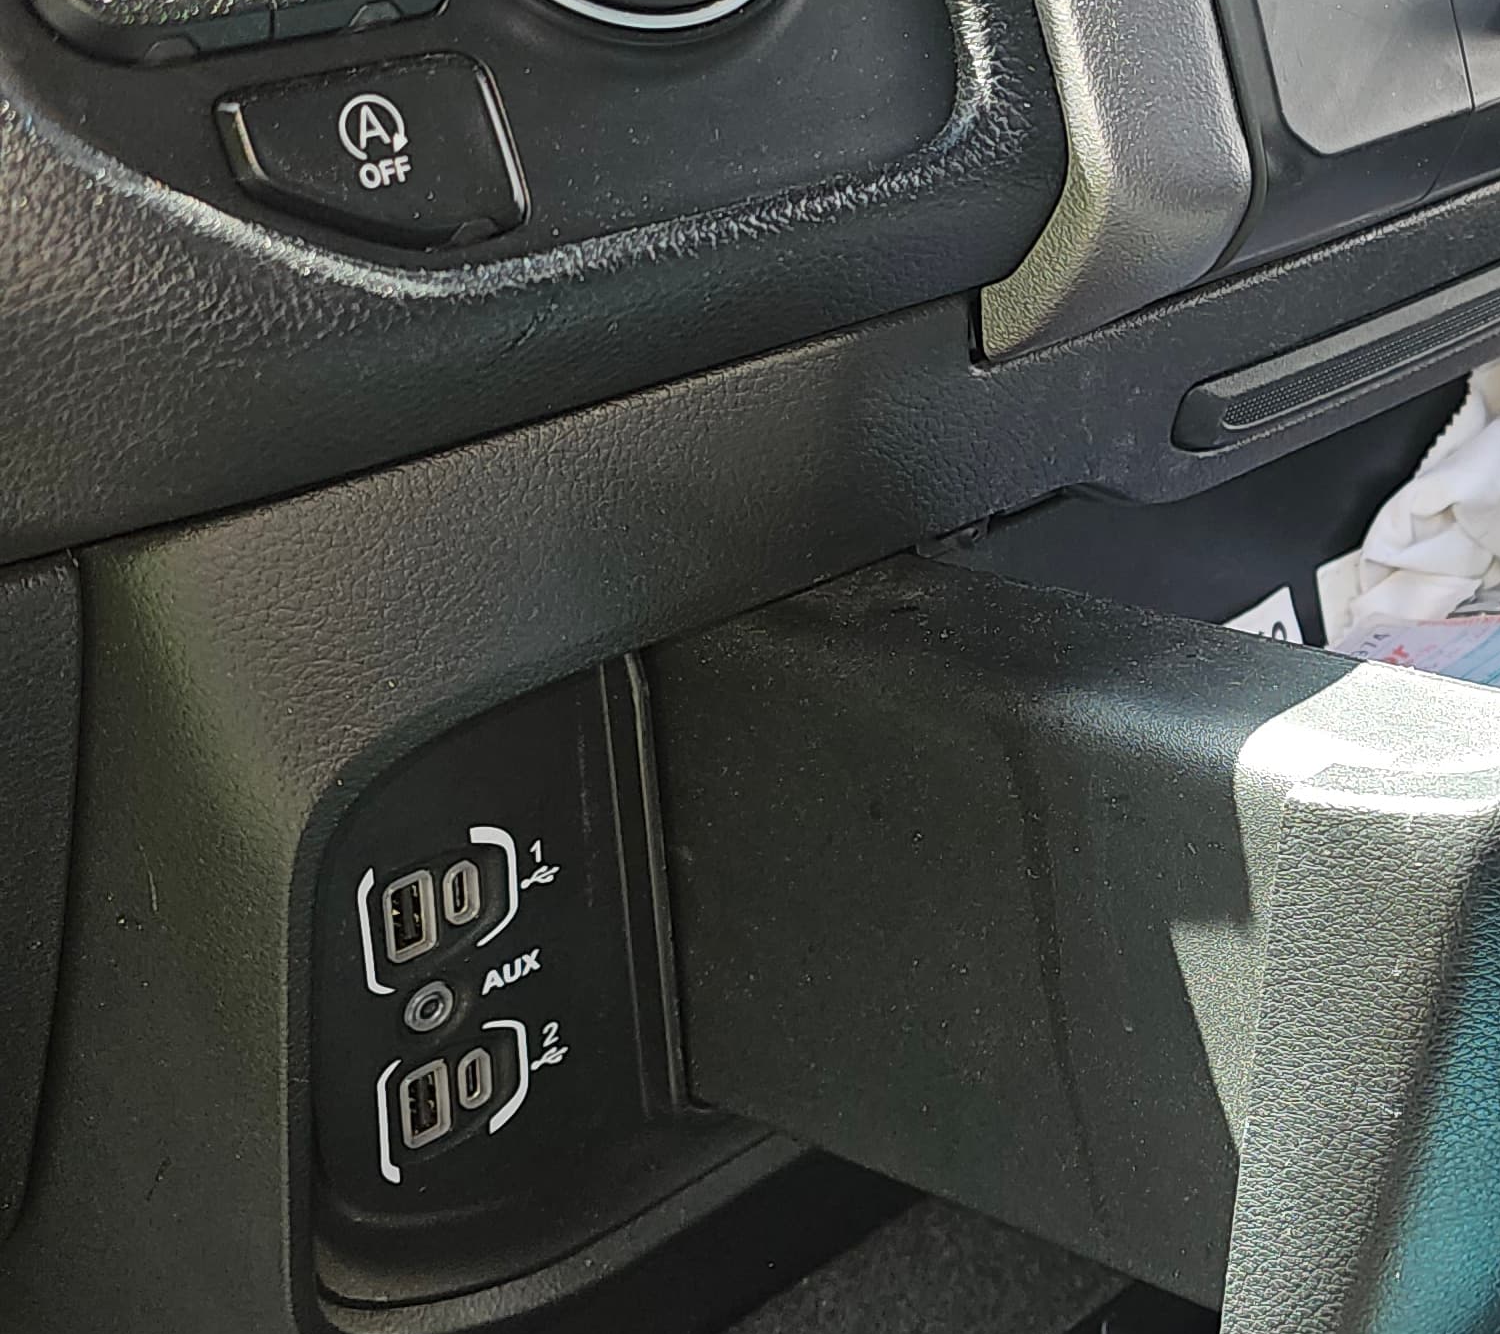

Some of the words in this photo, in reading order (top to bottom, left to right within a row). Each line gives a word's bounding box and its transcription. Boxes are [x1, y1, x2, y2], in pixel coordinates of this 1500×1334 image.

[359, 155, 411, 189] OFF
[529, 840, 544, 863] 1
[482, 949, 541, 995] AUX
[542, 1021, 559, 1048] 2
